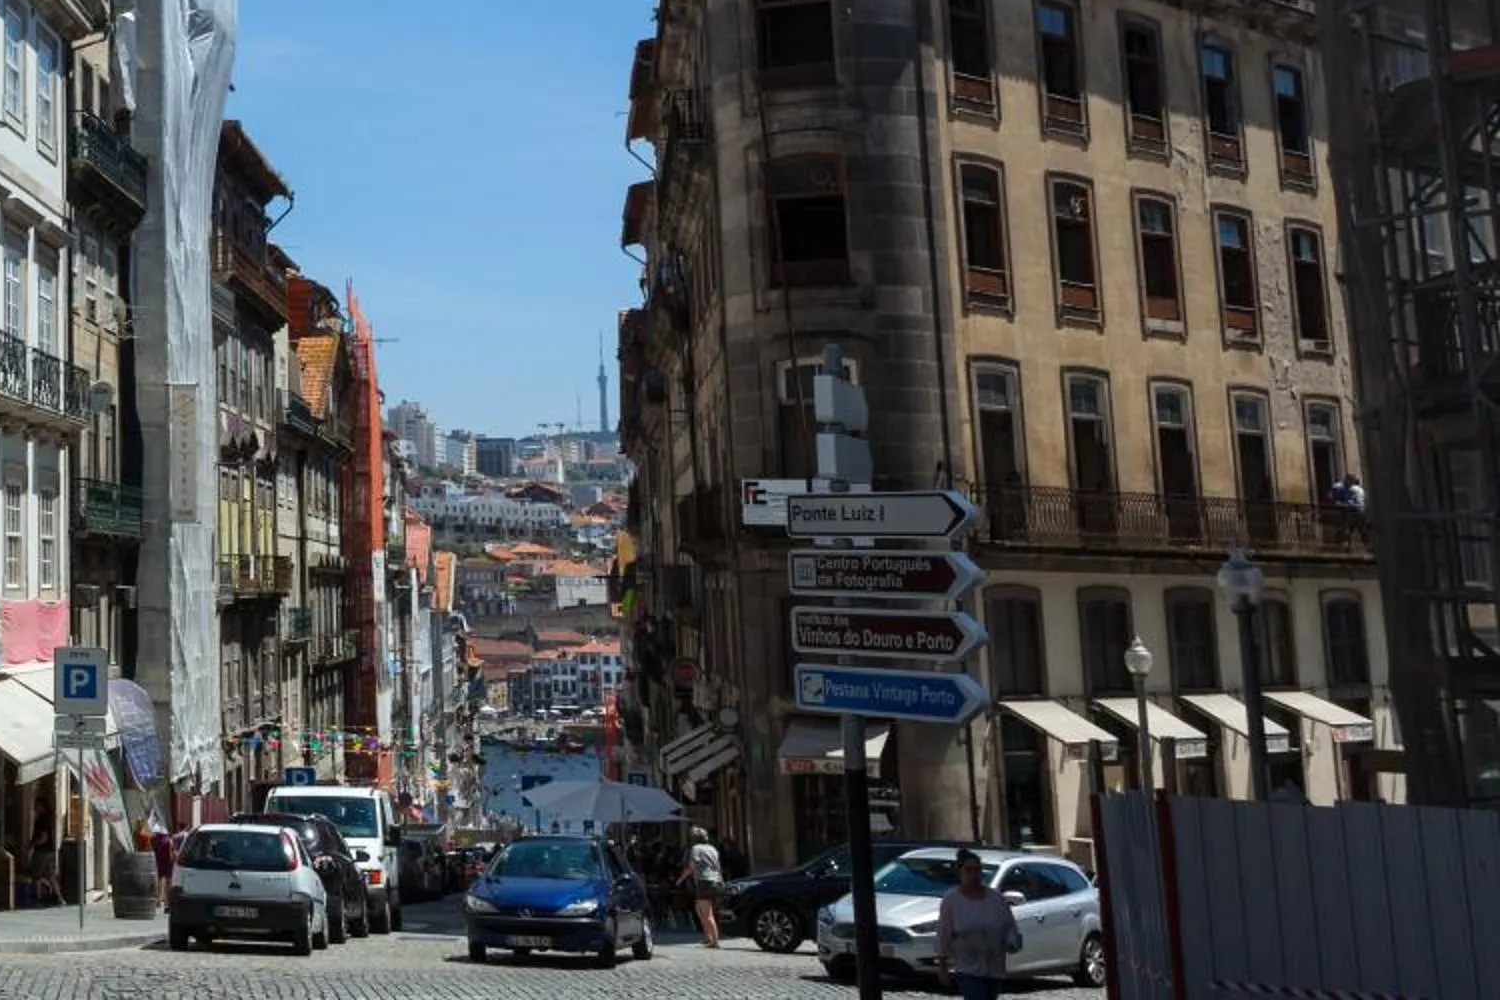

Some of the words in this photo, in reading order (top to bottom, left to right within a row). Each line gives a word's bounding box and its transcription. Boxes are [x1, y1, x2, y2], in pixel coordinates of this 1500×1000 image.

[792, 505, 837, 522] Ponte
[841, 504, 876, 522] Luiz
[817, 556, 859, 570] Centro
[863, 556, 932, 575] Português
[836, 573, 903, 590] Fotografia
[799, 629, 842, 646] Vinhos
[863, 630, 903, 648] Douro
[905, 636, 914, 648] e
[917, 632, 955, 650] Porto
[70, 669, 90, 696] P
[824, 679, 870, 698] Pestana
[871, 682, 918, 705] Vintage
[921, 686, 955, 705] Porto
